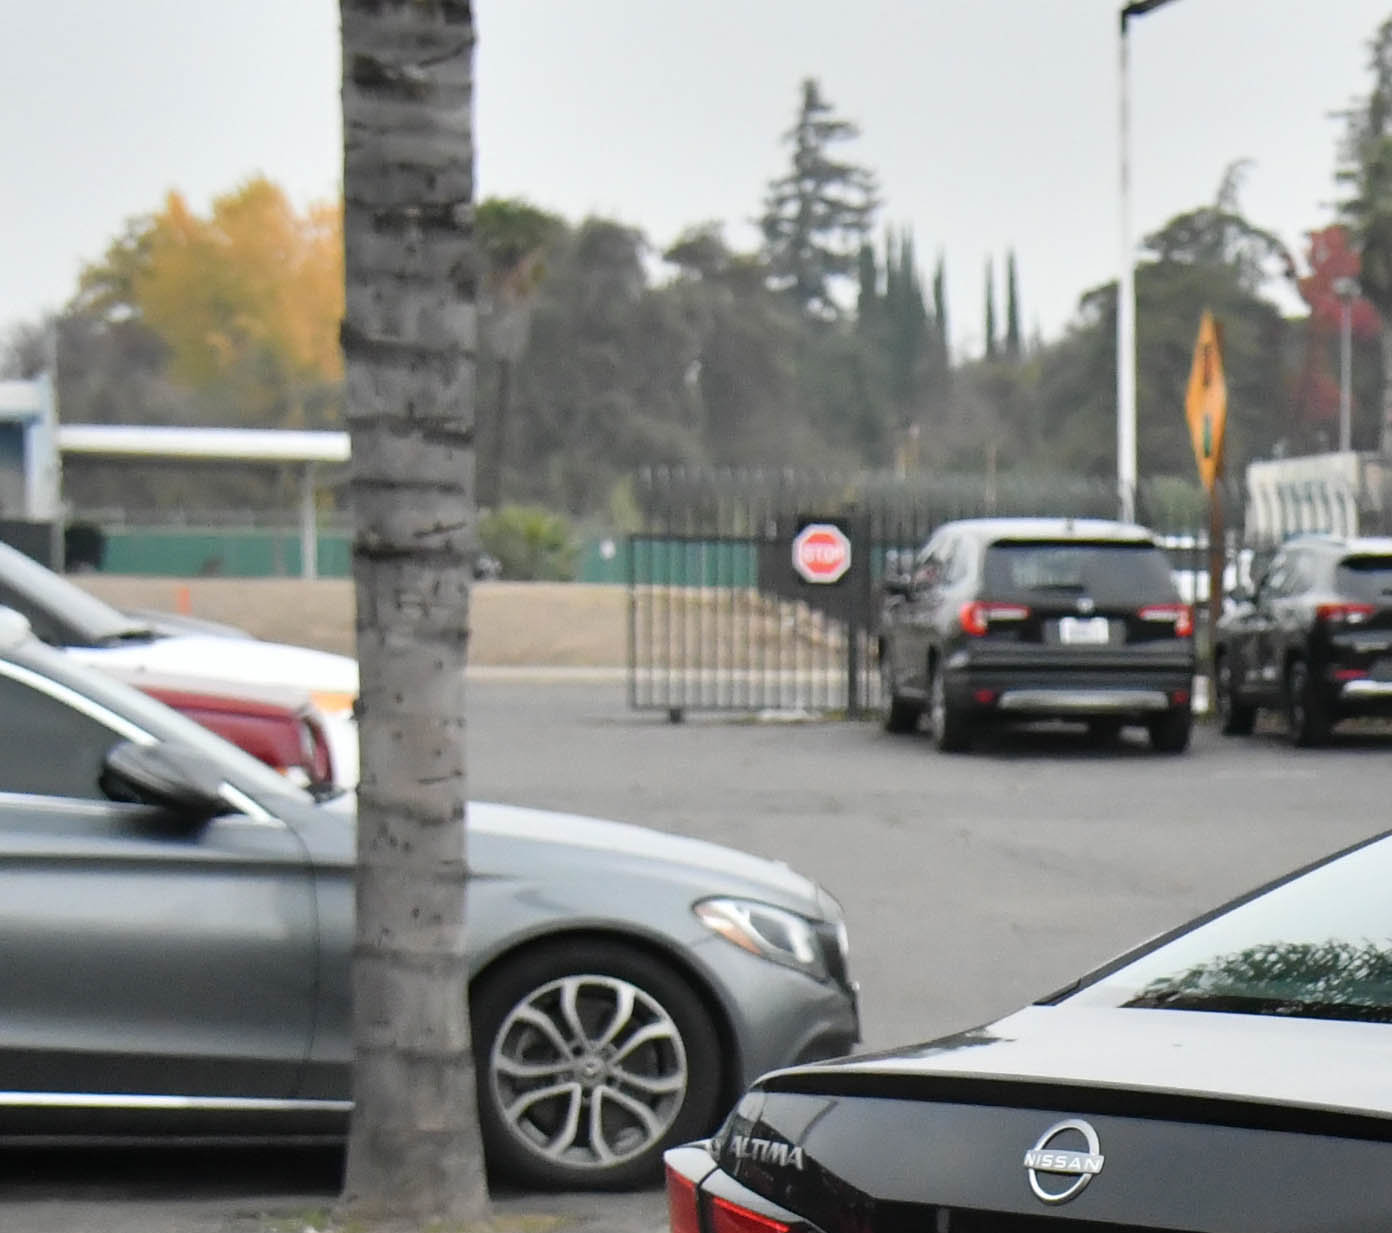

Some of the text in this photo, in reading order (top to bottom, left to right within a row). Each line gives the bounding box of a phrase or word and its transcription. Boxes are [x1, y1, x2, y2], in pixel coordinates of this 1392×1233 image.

[800, 542, 845, 564] STOP
[731, 1136, 804, 1170] ALTIMA
[1023, 1151, 1103, 1174] NISSAN
